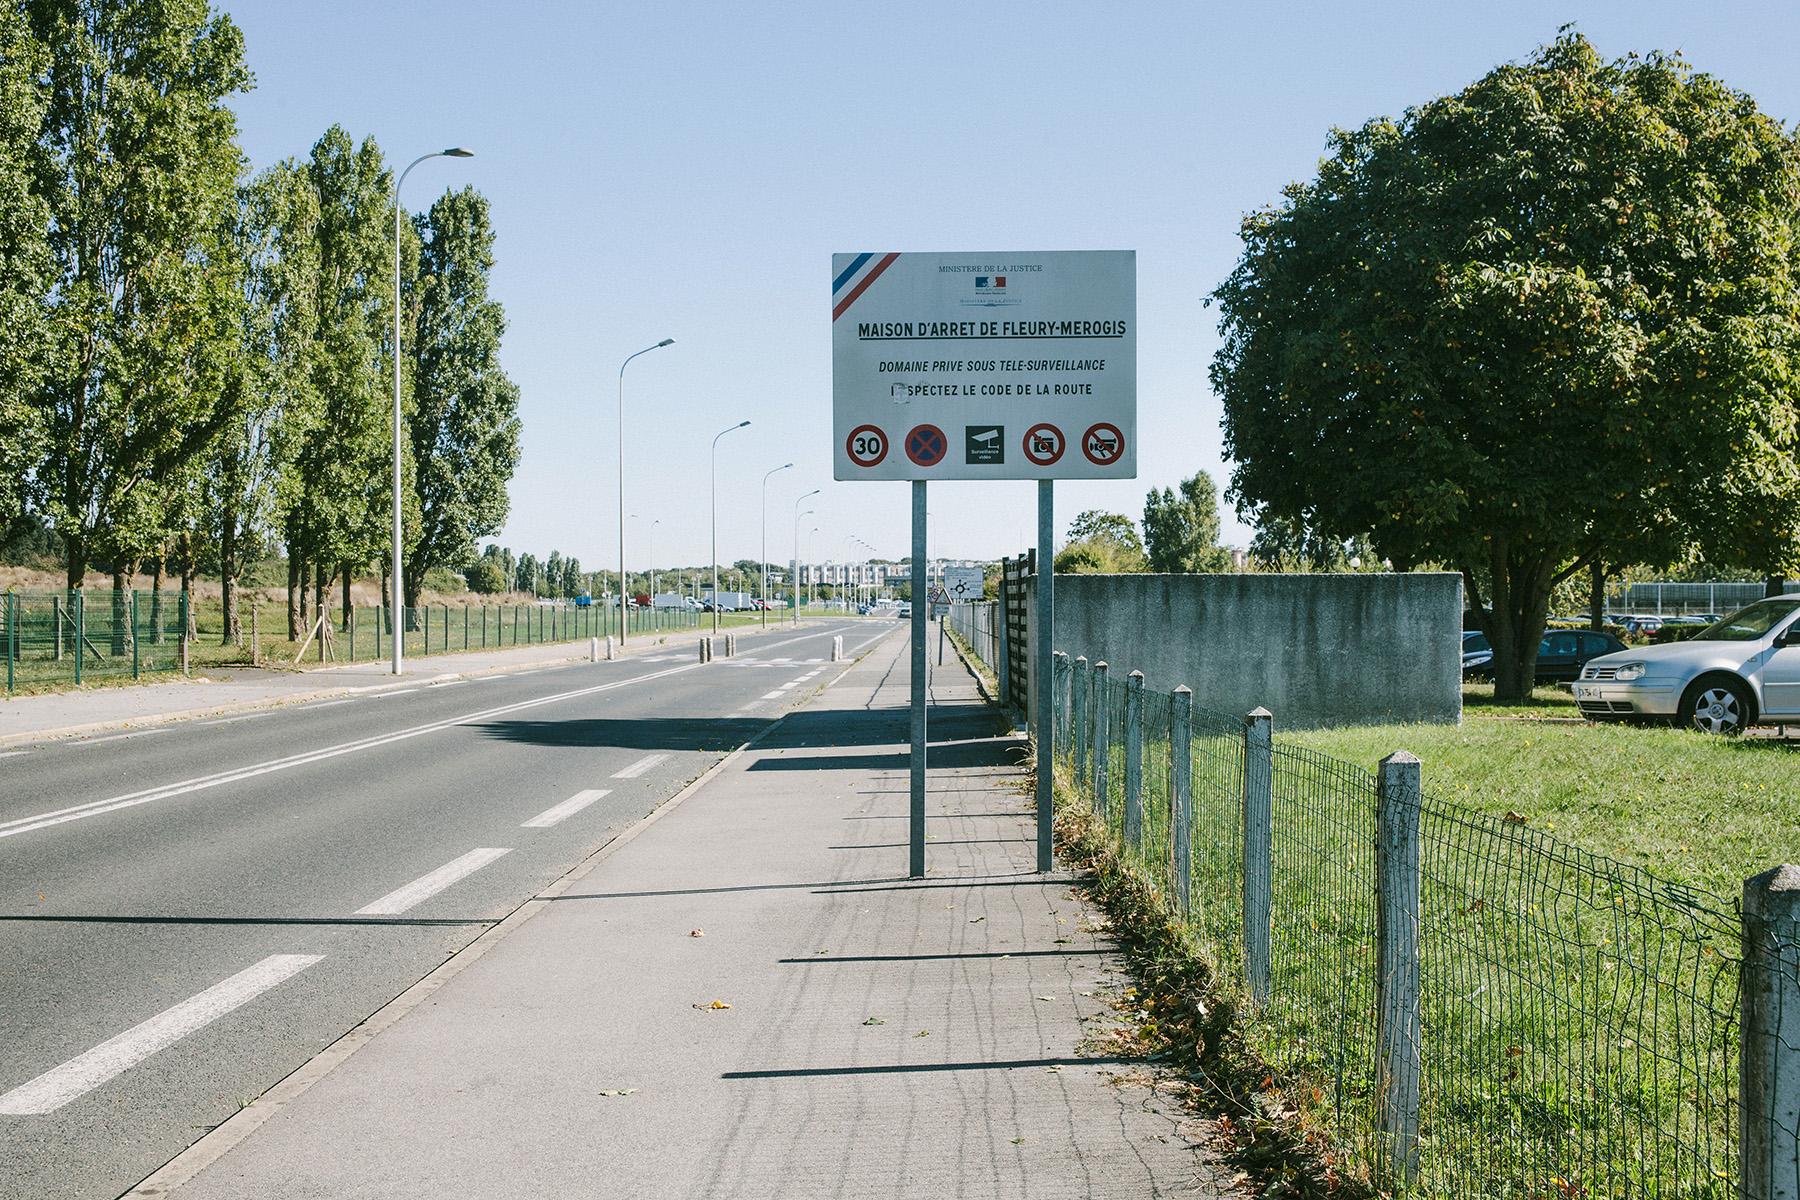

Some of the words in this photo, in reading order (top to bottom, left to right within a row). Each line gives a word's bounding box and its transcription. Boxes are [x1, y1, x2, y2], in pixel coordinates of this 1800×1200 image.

[939, 265, 982, 273] MINISTERE
[984, 265, 995, 273] DE
[1009, 264, 1043, 272] JUSTICE
[858, 322, 913, 337] MAISON
[918, 321, 976, 337] D'ARRET
[980, 321, 998, 336] DE
[1003, 320, 1126, 336] FLEURY-MEROGIS
[879, 361, 929, 373] DOMAINE
[932, 360, 963, 372] PRIVE
[966, 360, 996, 372] SOUS
[1000, 359, 1106, 371] TELE-SURVEILLANCE
[891, 385, 958, 396] SPECTEZ
[963, 384, 976, 396] LE
[981, 384, 1012, 396] CODE
[1016, 384, 1031, 396] DE
[1036, 383, 1050, 395] LA
[1054, 383, 1093, 395] ROUTE
[855, 437, 880, 455] 30
